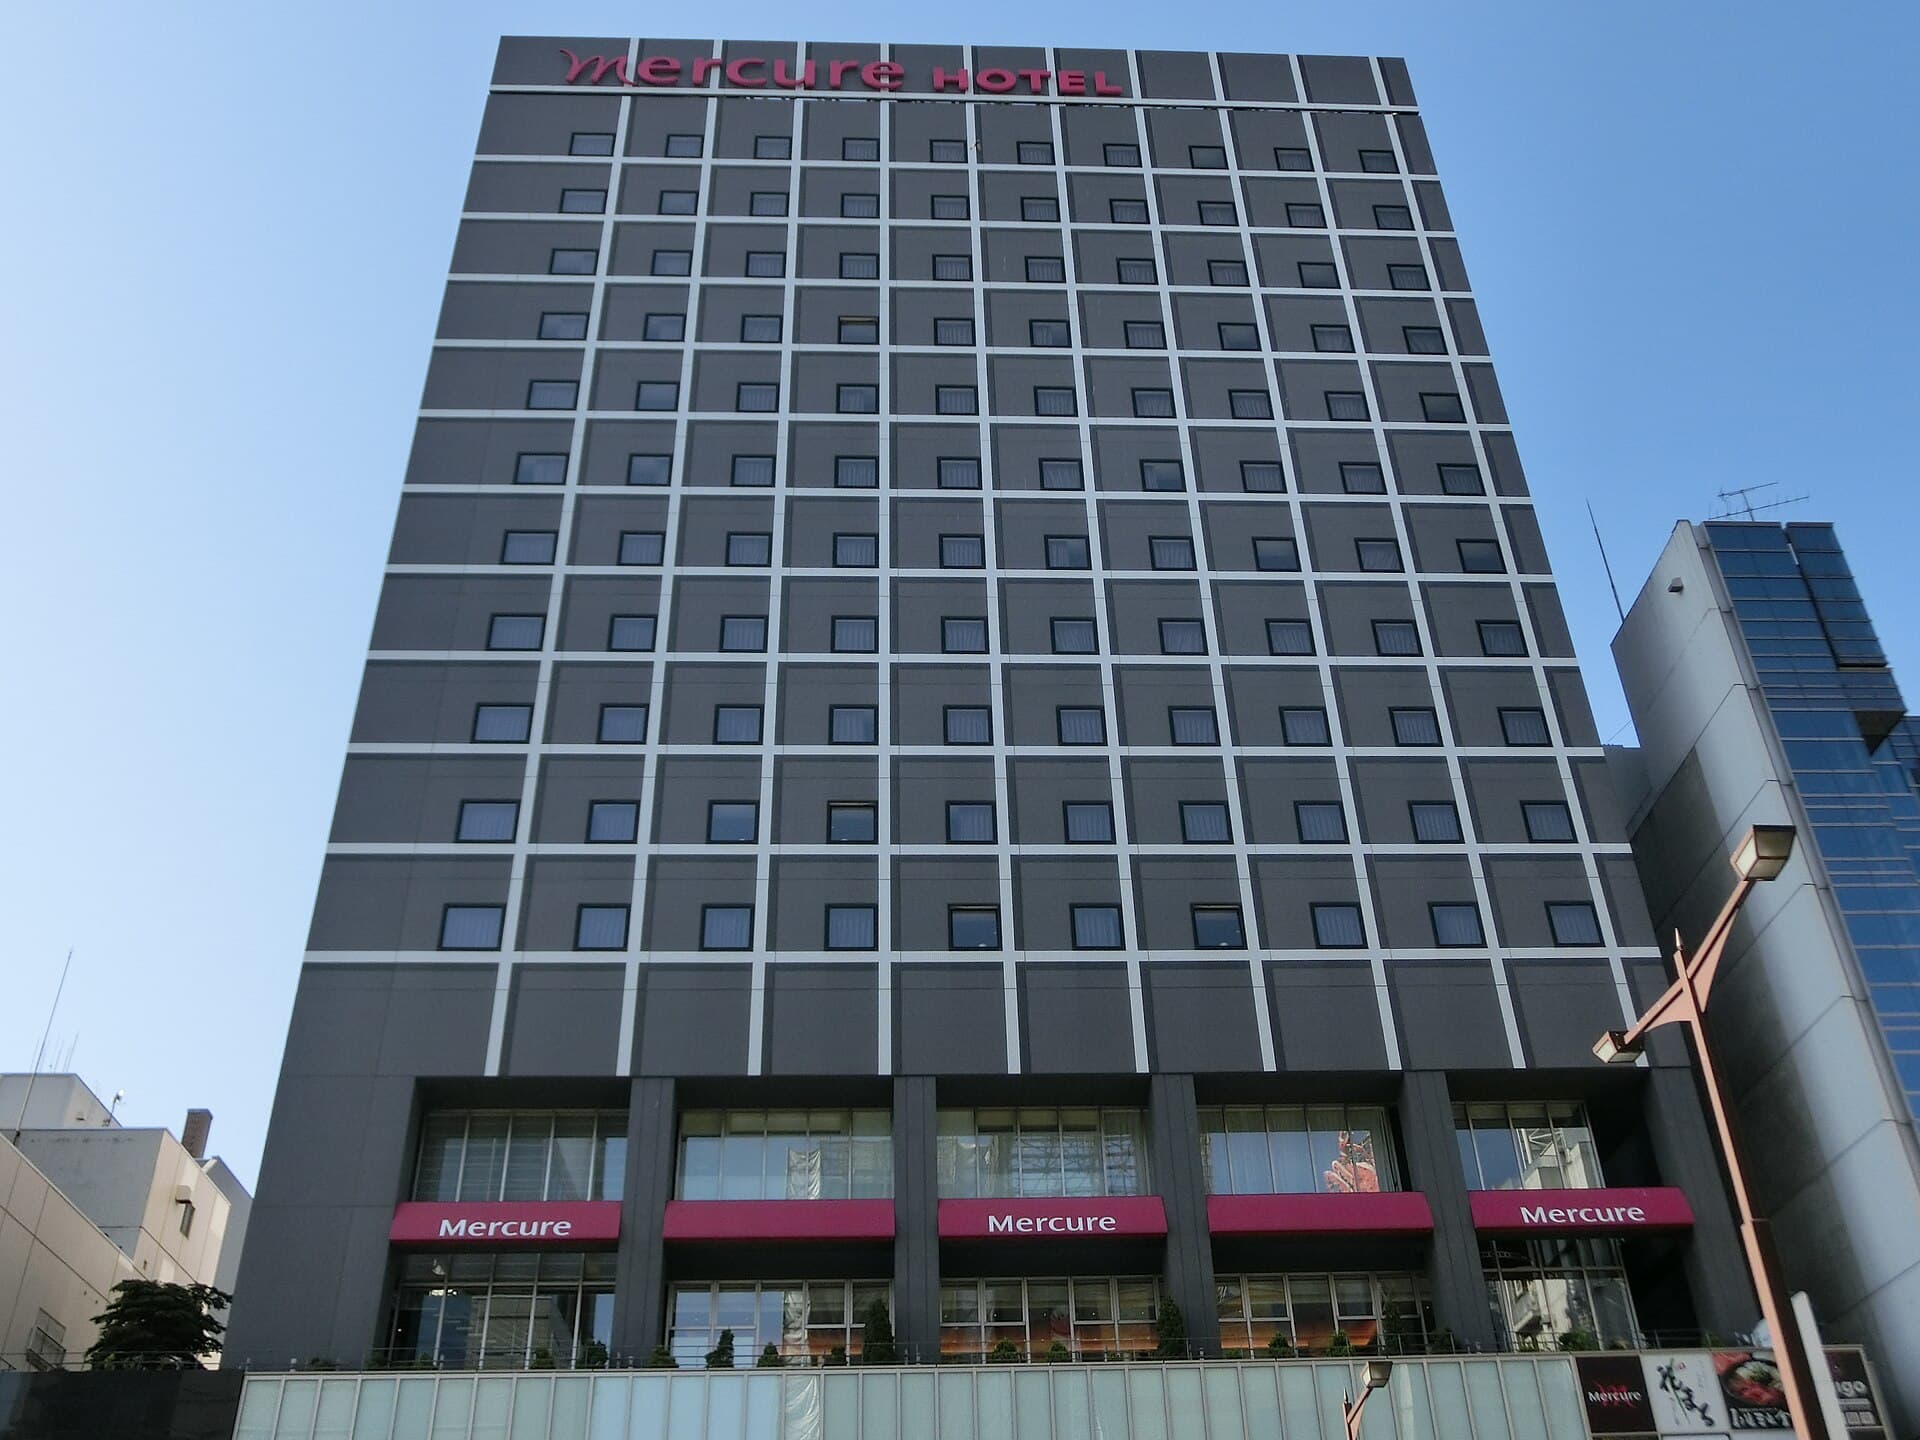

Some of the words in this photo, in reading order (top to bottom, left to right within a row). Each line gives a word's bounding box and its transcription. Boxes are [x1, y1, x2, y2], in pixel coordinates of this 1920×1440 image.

[933, 66, 1122, 95] HOTEL
[987, 1213, 1117, 1234] Mercure
[1519, 1205, 1646, 1224] Mercure
[438, 1218, 573, 1238] Mercure
[1588, 1391, 1641, 1402] Mercure
